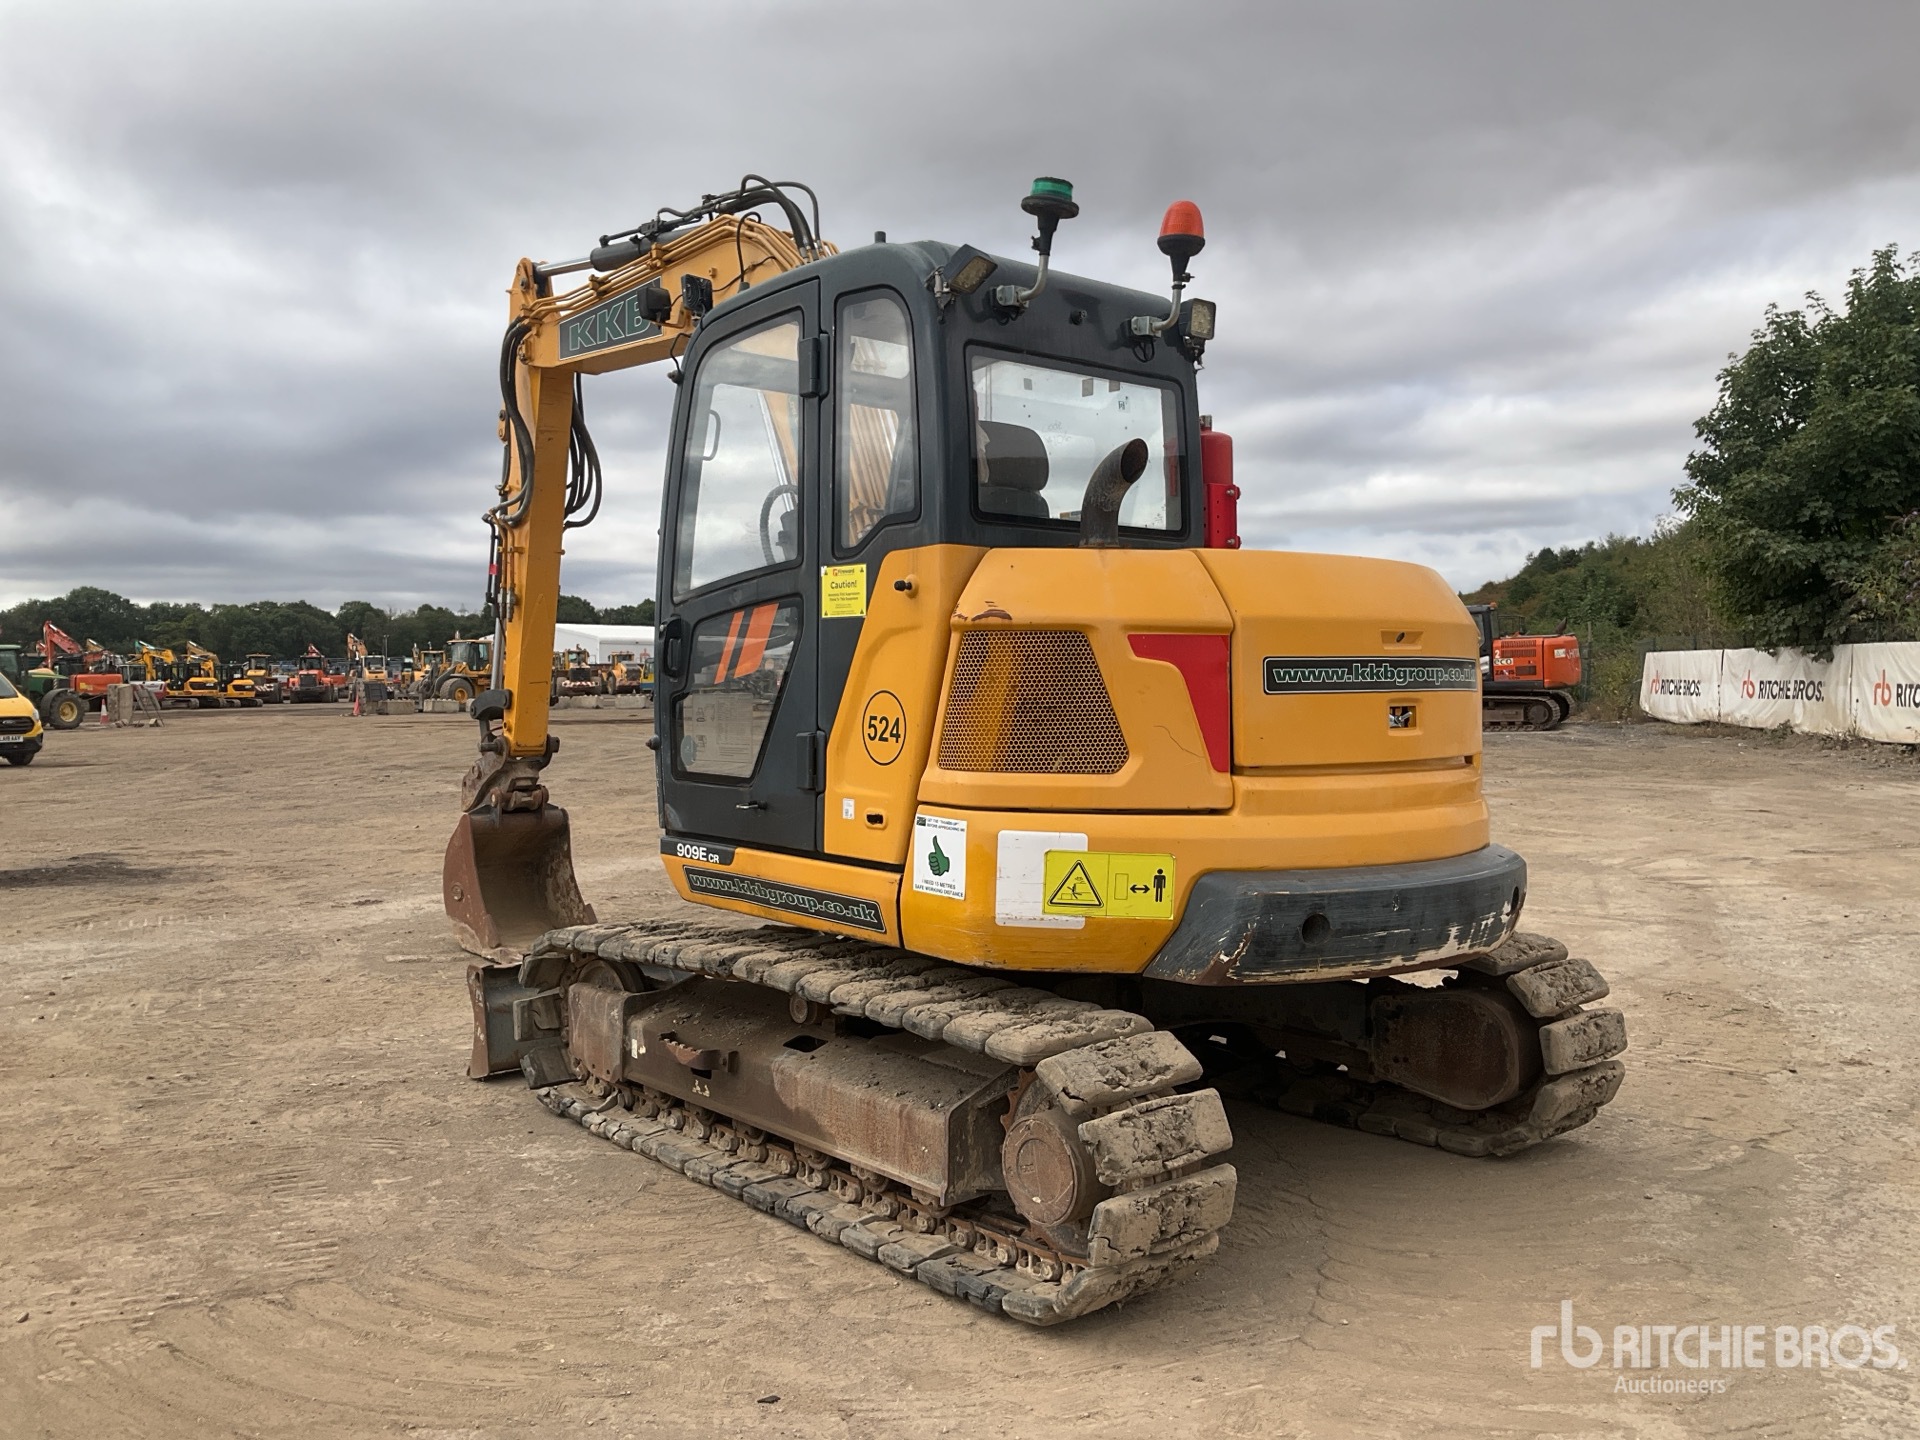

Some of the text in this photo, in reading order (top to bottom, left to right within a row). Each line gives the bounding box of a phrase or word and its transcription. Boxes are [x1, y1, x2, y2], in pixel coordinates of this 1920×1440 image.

[830, 580, 857, 589] Caution!
[1493, 658, 1512, 666] eco
[1661, 679, 1682, 695] RITCHIE
[1758, 680, 1791, 700] RITCHIE
[867, 715, 901, 744] 524
[676, 843, 720, 864] 909E CR
[690, 873, 878, 923] www.kkbgroup.co.uk
